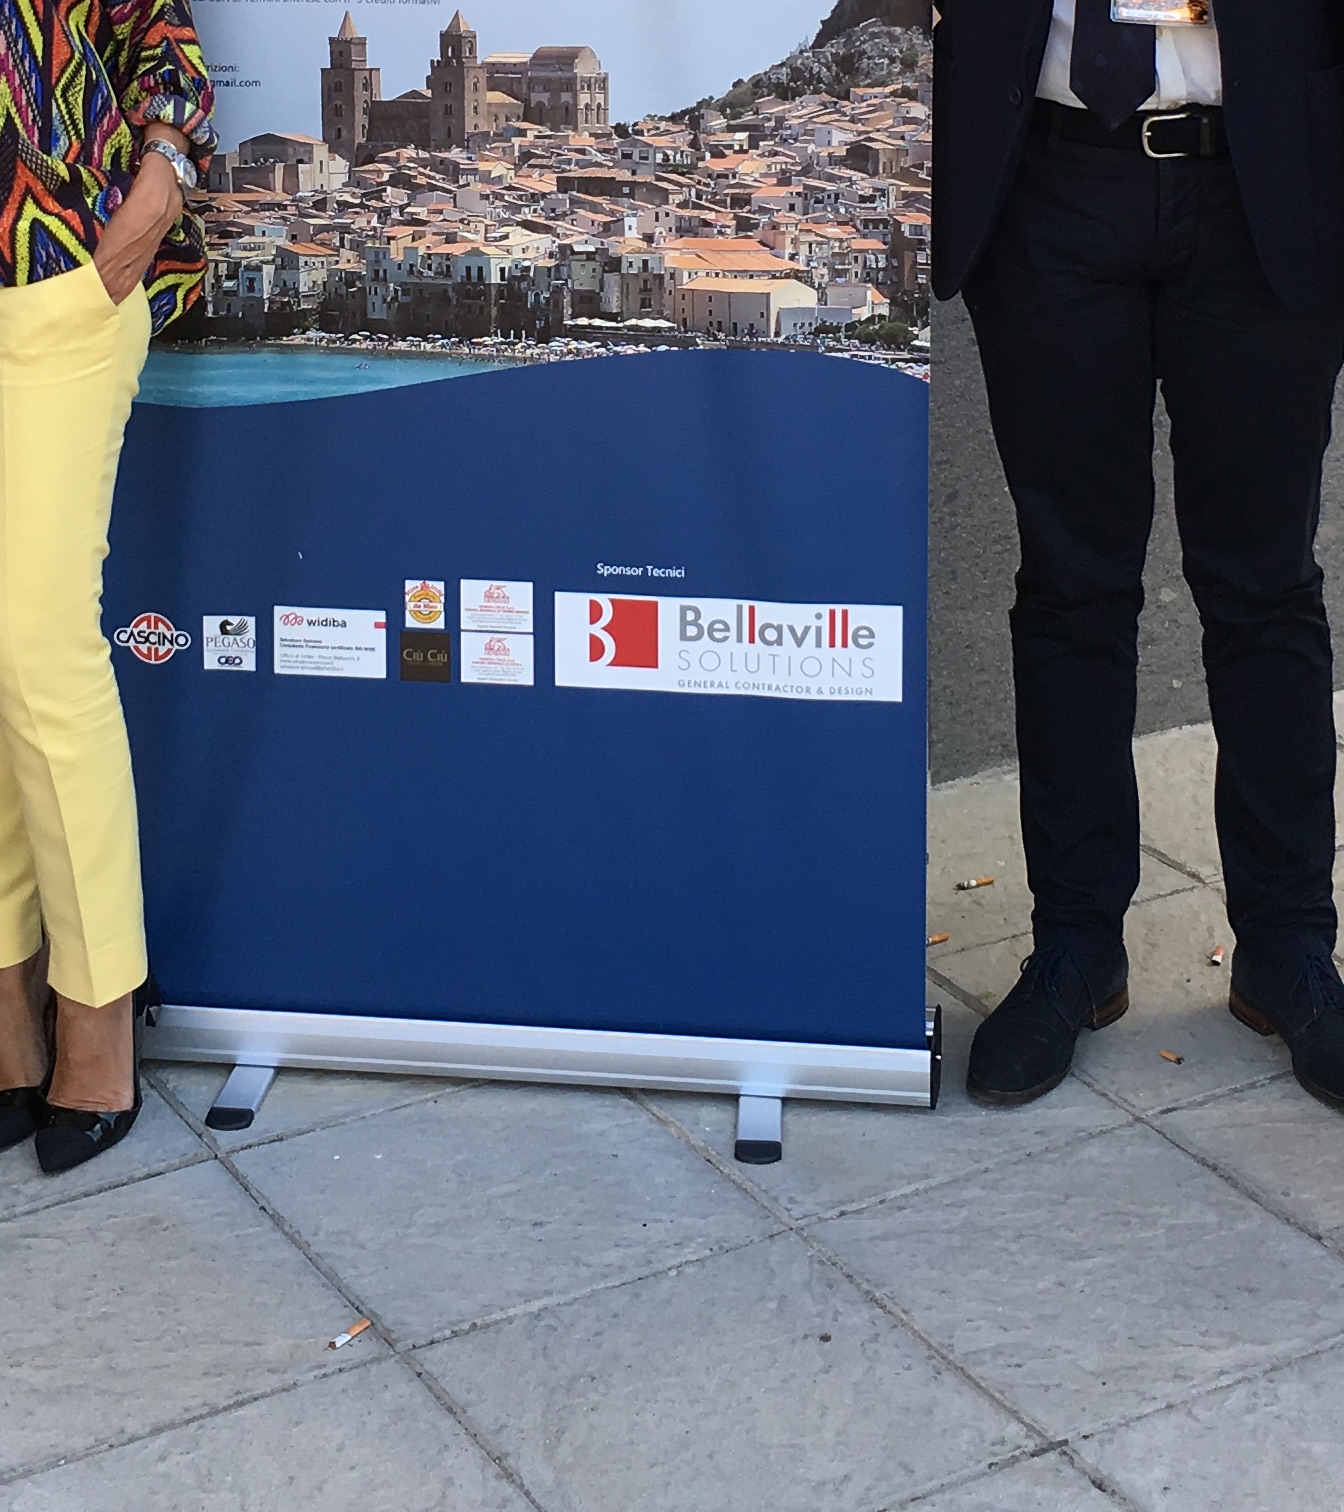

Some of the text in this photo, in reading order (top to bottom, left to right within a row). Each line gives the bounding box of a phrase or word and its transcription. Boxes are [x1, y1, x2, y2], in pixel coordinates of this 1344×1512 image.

[596, 562, 684, 577] Sponsor Tecnici
[307, 617, 347, 629] widiba
[679, 603, 875, 650] Bellaville
[116, 629, 190, 649] CASCINO
[206, 636, 256, 649] PEGASO
[677, 648, 875, 679] SOLUTIONS
[677, 678, 873, 695] GENERAL CONTRACTOR & DESIGN
